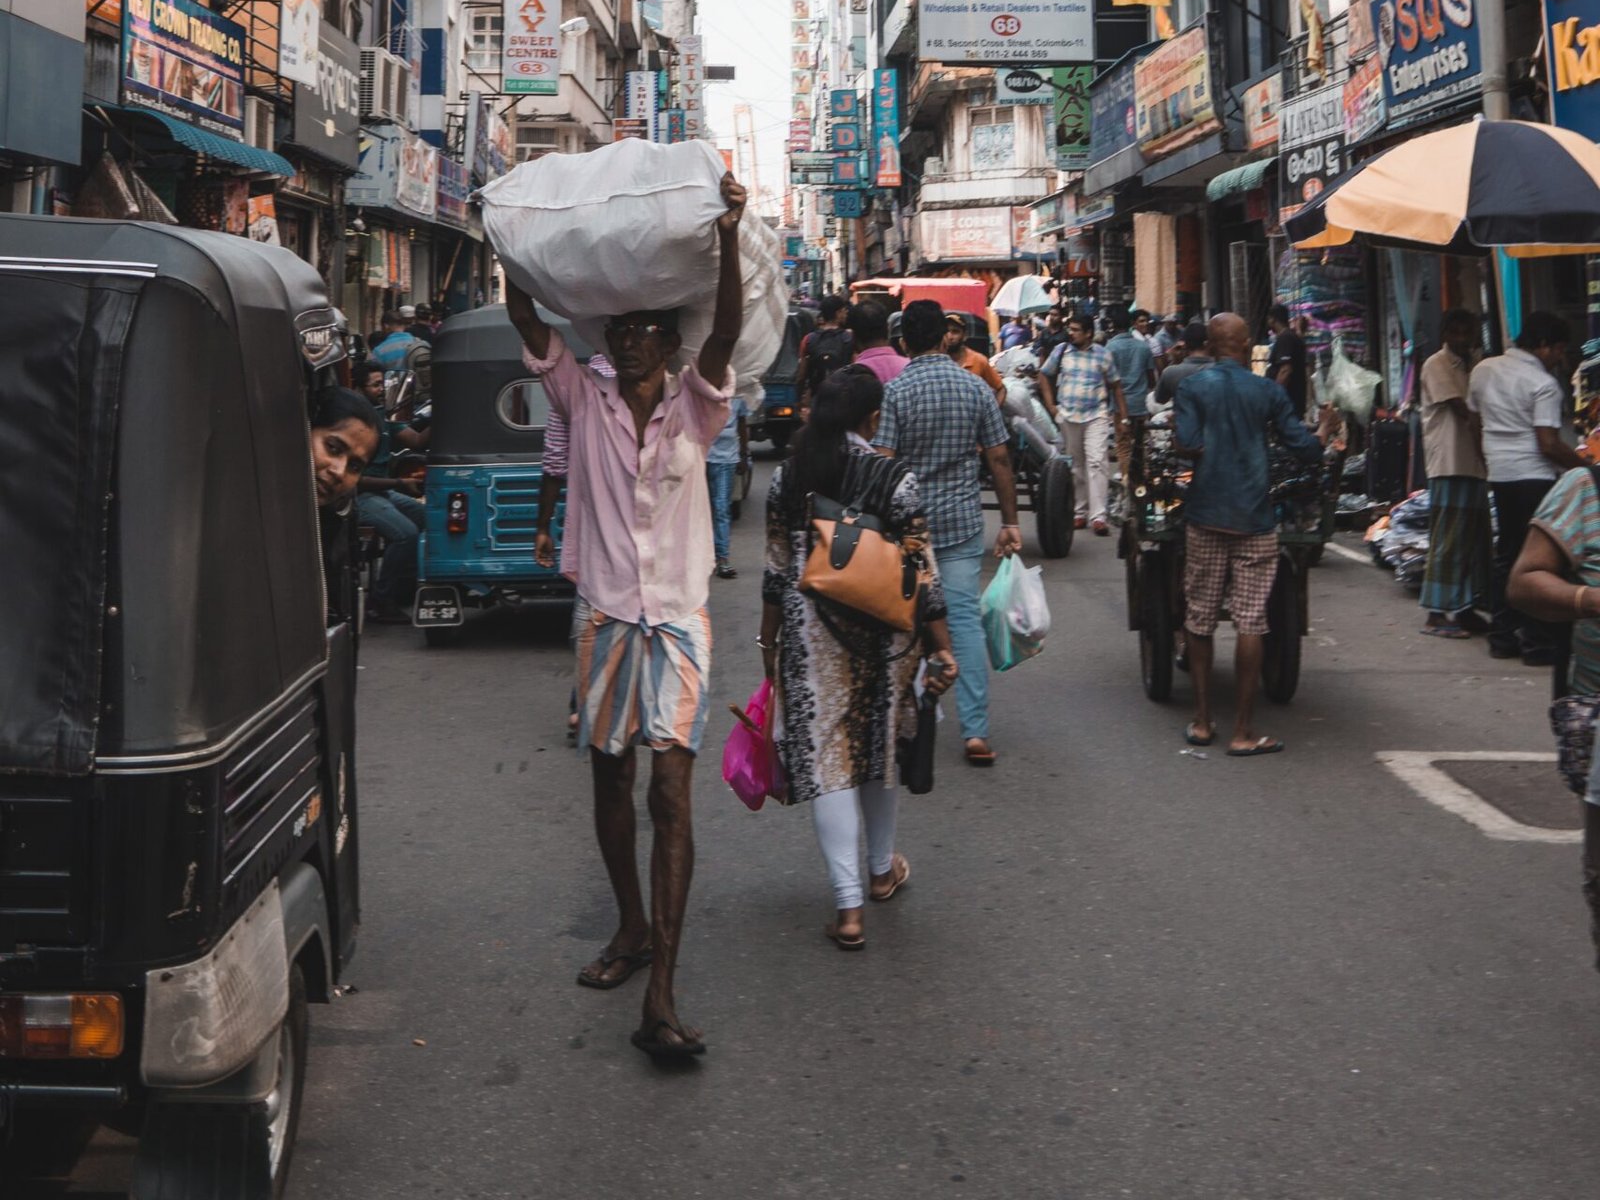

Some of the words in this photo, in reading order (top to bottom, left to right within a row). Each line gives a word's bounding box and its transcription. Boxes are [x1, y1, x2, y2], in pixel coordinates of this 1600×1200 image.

[924, 3, 969, 14] Wholesale
[980, 3, 1006, 13] Retail
[1007, 3, 1040, 13] Dealers
[1042, 3, 1051, 13] in
[1053, 3, 1087, 13] Textiles
[994, 17, 1019, 34] 68
[189, 15, 228, 59] TRADING
[509, 35, 554, 46] SWEET
[948, 38, 978, 48] Second
[980, 38, 1005, 48] Cross
[505, 47, 558, 59] CENTRE
[793, 0, 809, 112] RAMYA
[519, 63, 543, 73] 63
[1388, 40, 1469, 97] Enterprises
[953, 229, 984, 242] SHOP
[1073, 252, 1098, 274] 70
[418, 607, 458, 620] RE-SP
